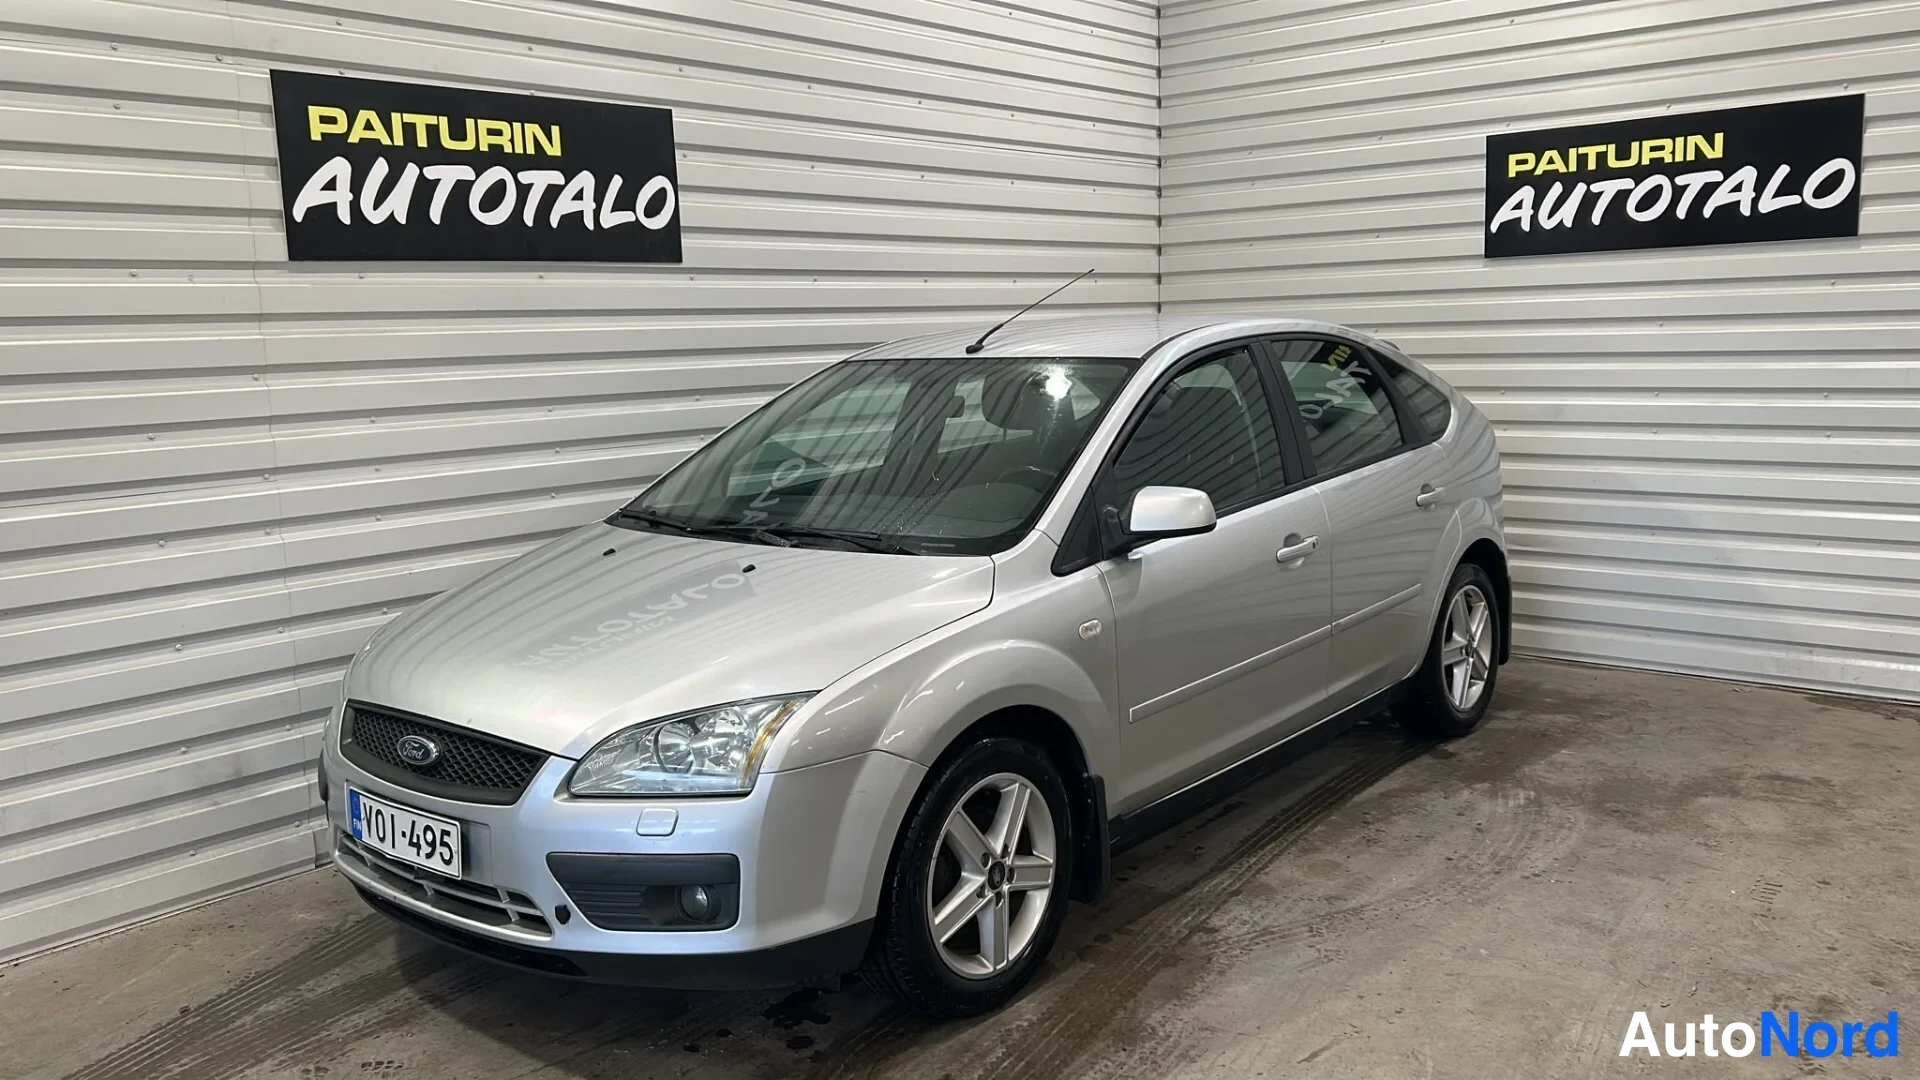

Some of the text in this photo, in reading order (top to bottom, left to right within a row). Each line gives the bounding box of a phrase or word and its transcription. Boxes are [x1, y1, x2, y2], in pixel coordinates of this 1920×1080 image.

[307, 105, 562, 156] PAITURIN
[1508, 132, 1724, 178] PAITURIN
[292, 156, 676, 231] AUTOTALO
[1490, 157, 1856, 234] AUTOTALO
[402, 741, 425, 759] Ford
[363, 802, 454, 866] VOI-495
